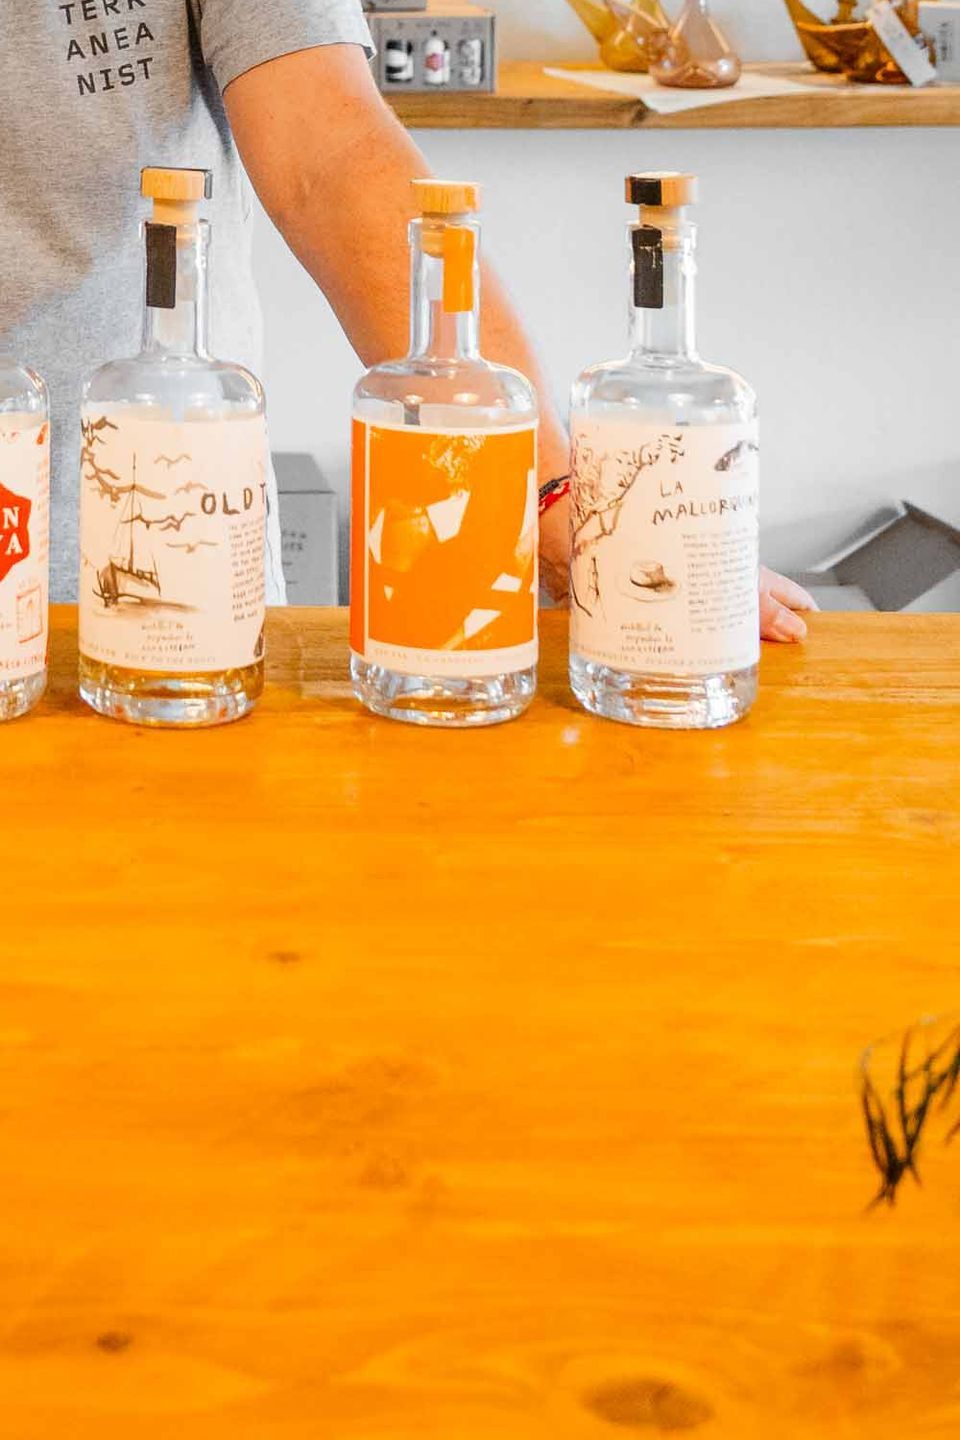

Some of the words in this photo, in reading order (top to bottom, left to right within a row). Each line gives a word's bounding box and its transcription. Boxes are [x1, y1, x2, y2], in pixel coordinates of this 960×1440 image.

[67, 22, 155, 61] ANEA
[77, 57, 154, 95] NIST
[201, 486, 254, 515] OLD
[660, 479, 684, 498] LA
